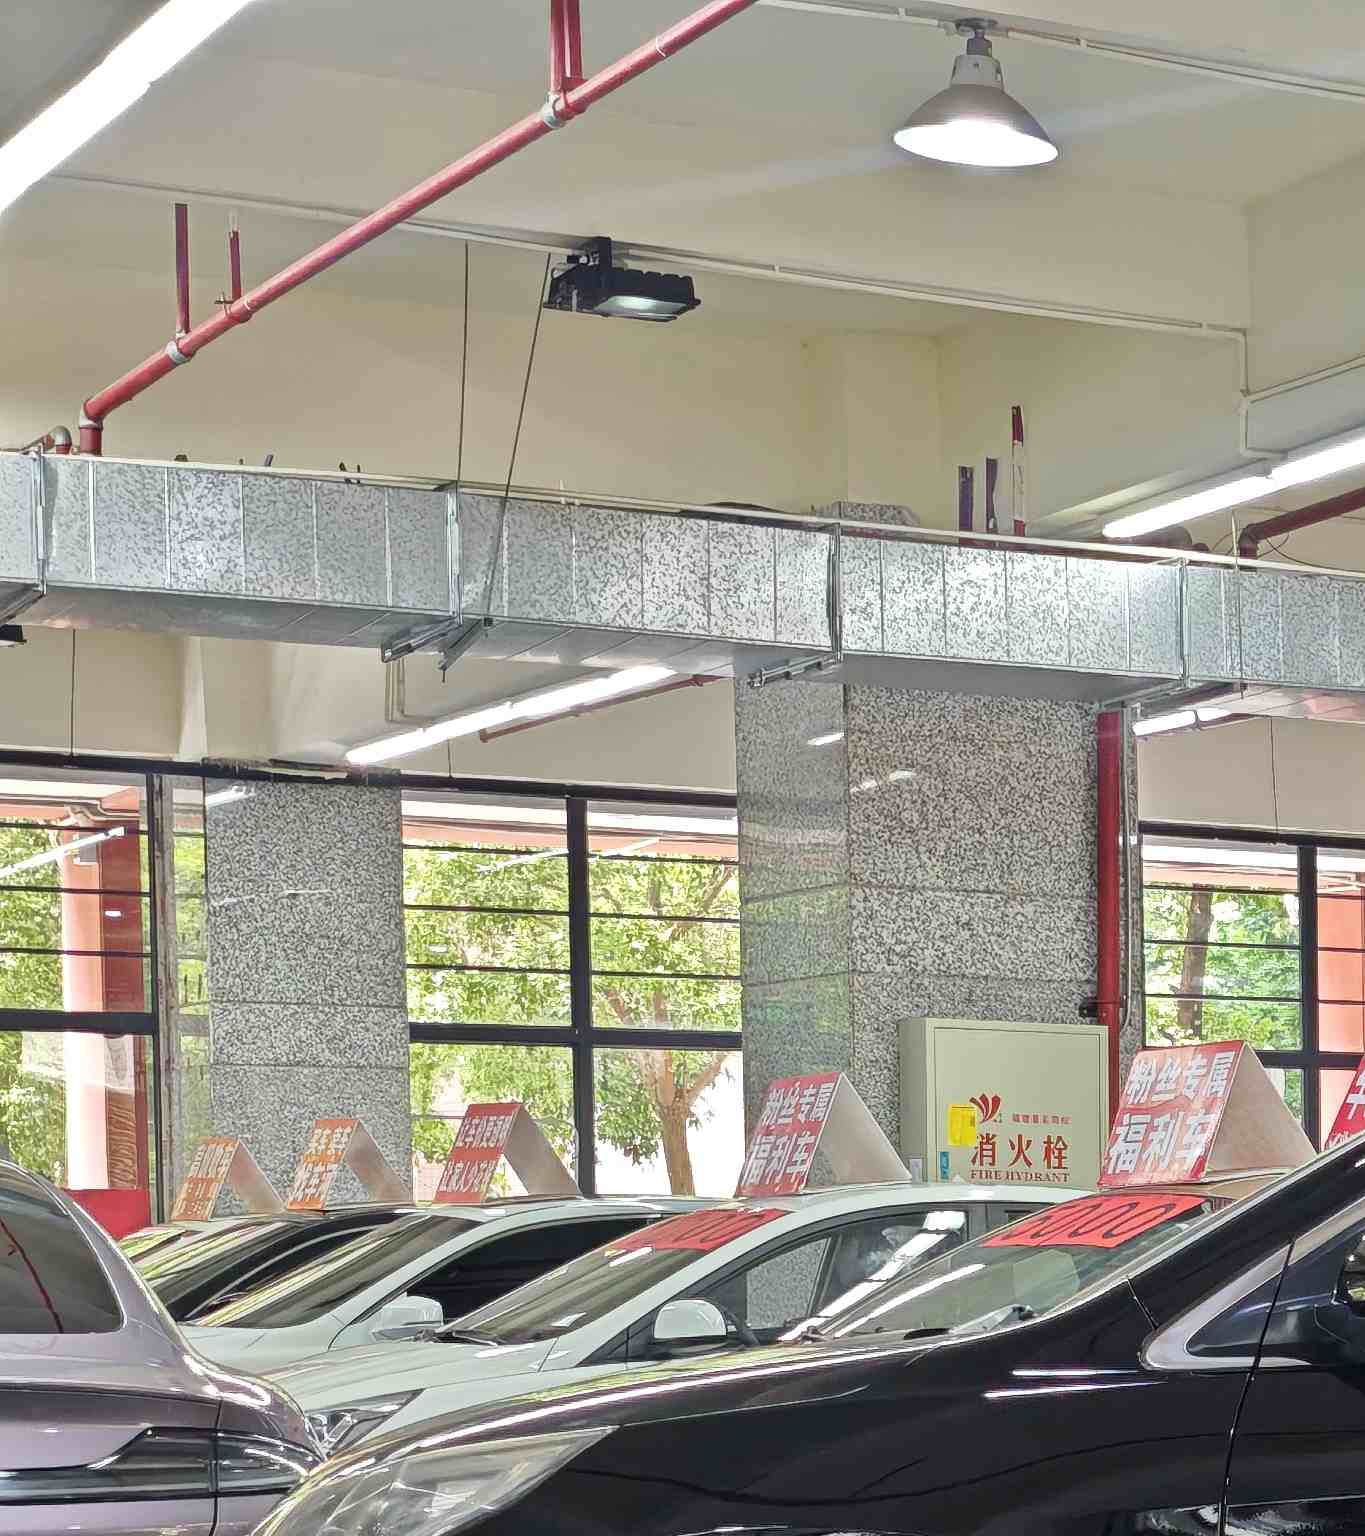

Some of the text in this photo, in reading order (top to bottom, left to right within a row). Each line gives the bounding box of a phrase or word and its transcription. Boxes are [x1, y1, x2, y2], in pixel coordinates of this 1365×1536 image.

[761, 1078, 835, 1128] 粉丝专属
[1126, 1051, 1236, 1106] 粉丝专属
[741, 1131, 815, 1188] 福利车
[970, 1132, 1069, 1170] 消火栓
[1107, 1108, 1218, 1174] 福利车
[970, 1169, 1070, 1182] FIRE HYDRANT
